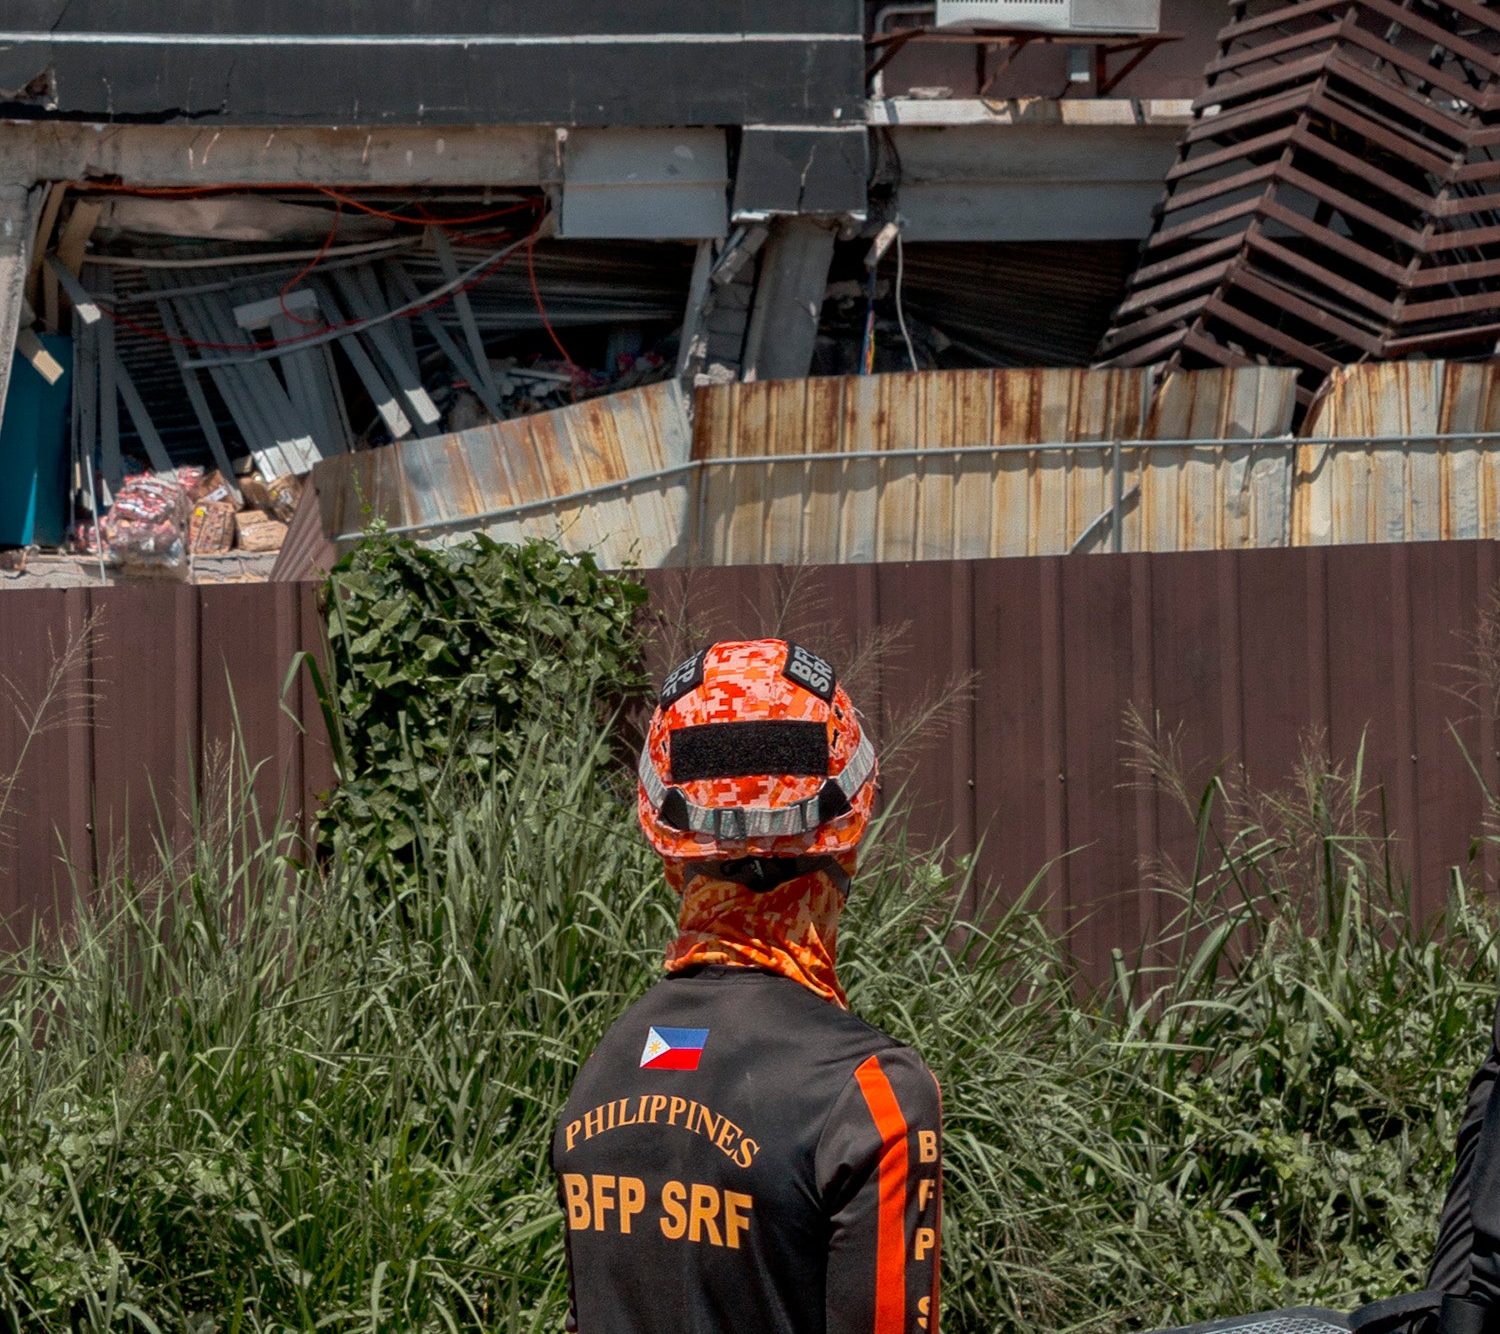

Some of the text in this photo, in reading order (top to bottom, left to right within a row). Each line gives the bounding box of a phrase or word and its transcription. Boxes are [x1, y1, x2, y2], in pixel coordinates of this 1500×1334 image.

[789, 645, 815, 682] BFP
[809, 655, 833, 693] SRF
[564, 1094, 761, 1168] PHILIPPINES
[563, 1173, 754, 1249] BFP SRF
[914, 1129, 938, 1261] BFP
